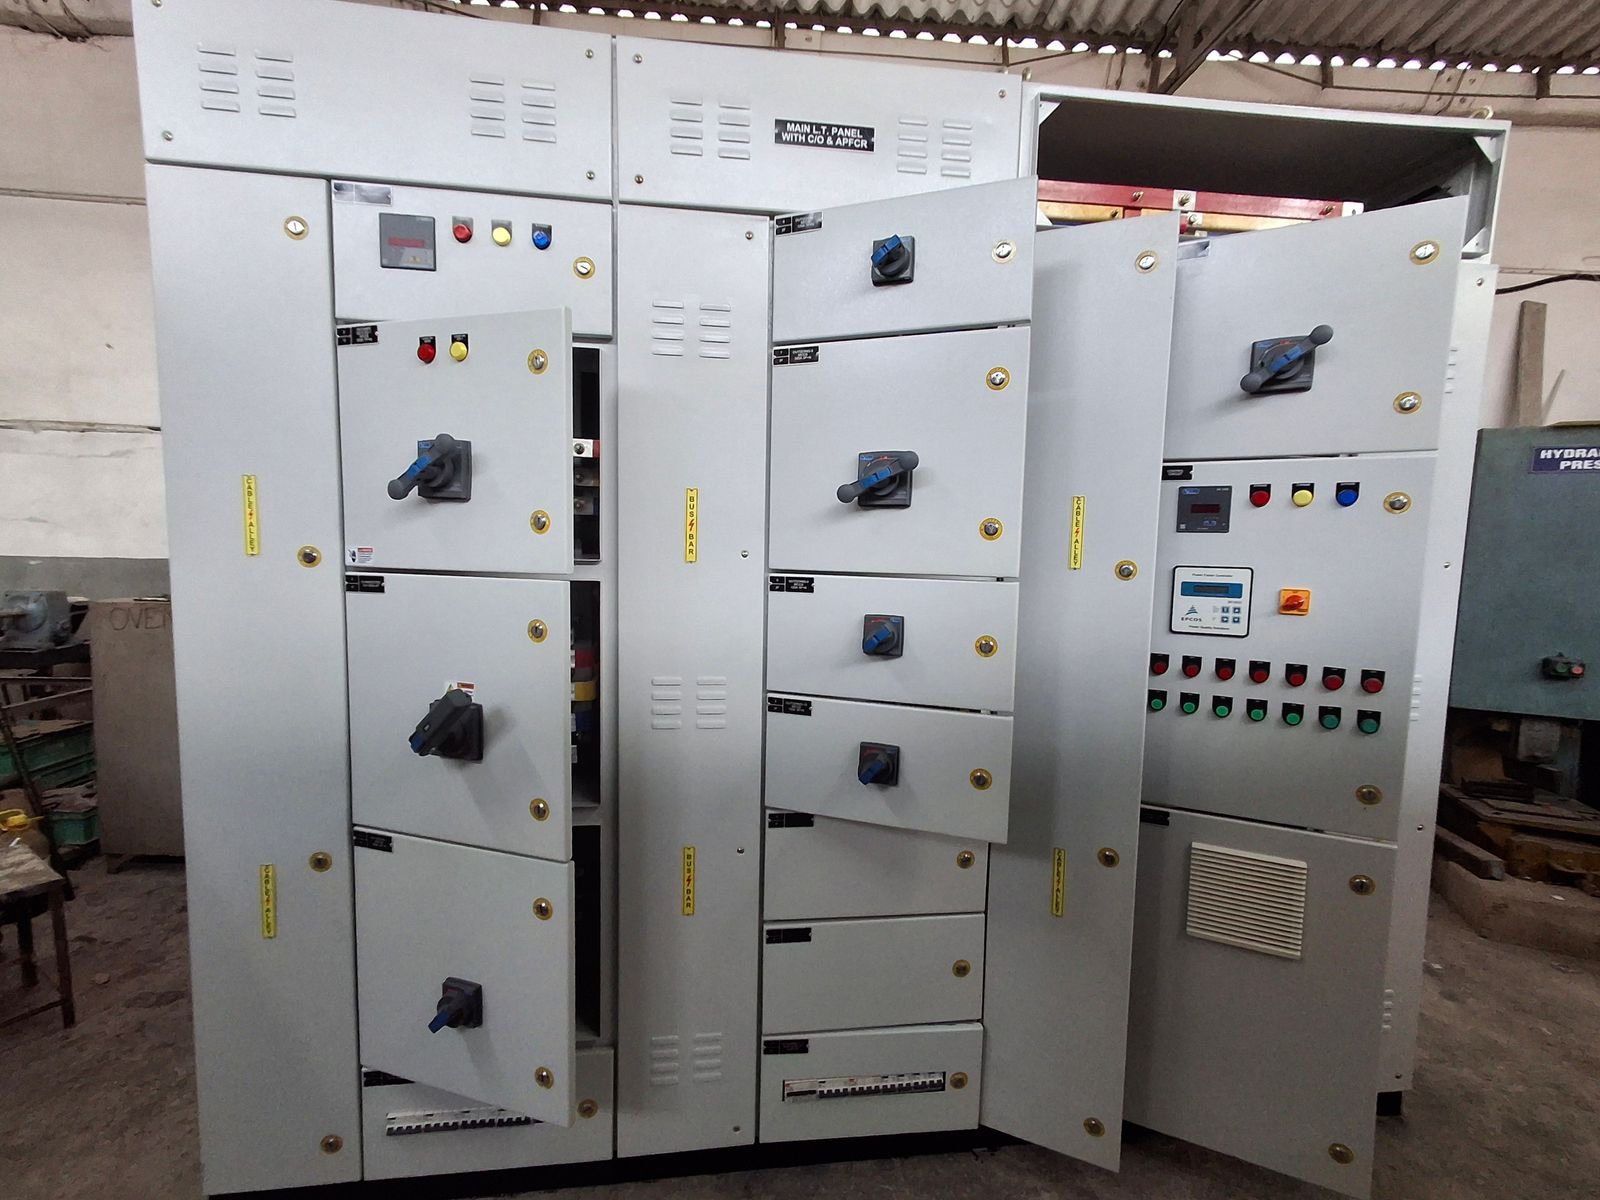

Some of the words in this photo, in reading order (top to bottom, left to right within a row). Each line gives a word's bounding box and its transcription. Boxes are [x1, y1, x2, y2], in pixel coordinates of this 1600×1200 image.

[786, 122, 811, 134] MAIN
[812, 125, 829, 136] L.T.
[831, 127, 863, 139] PANEL
[781, 132, 806, 143] WITH
[807, 134, 825, 145] C/O
[826, 136, 834, 146] &
[835, 137, 868, 149] APFCR
[1540, 448, 1600, 459] HYDRA
